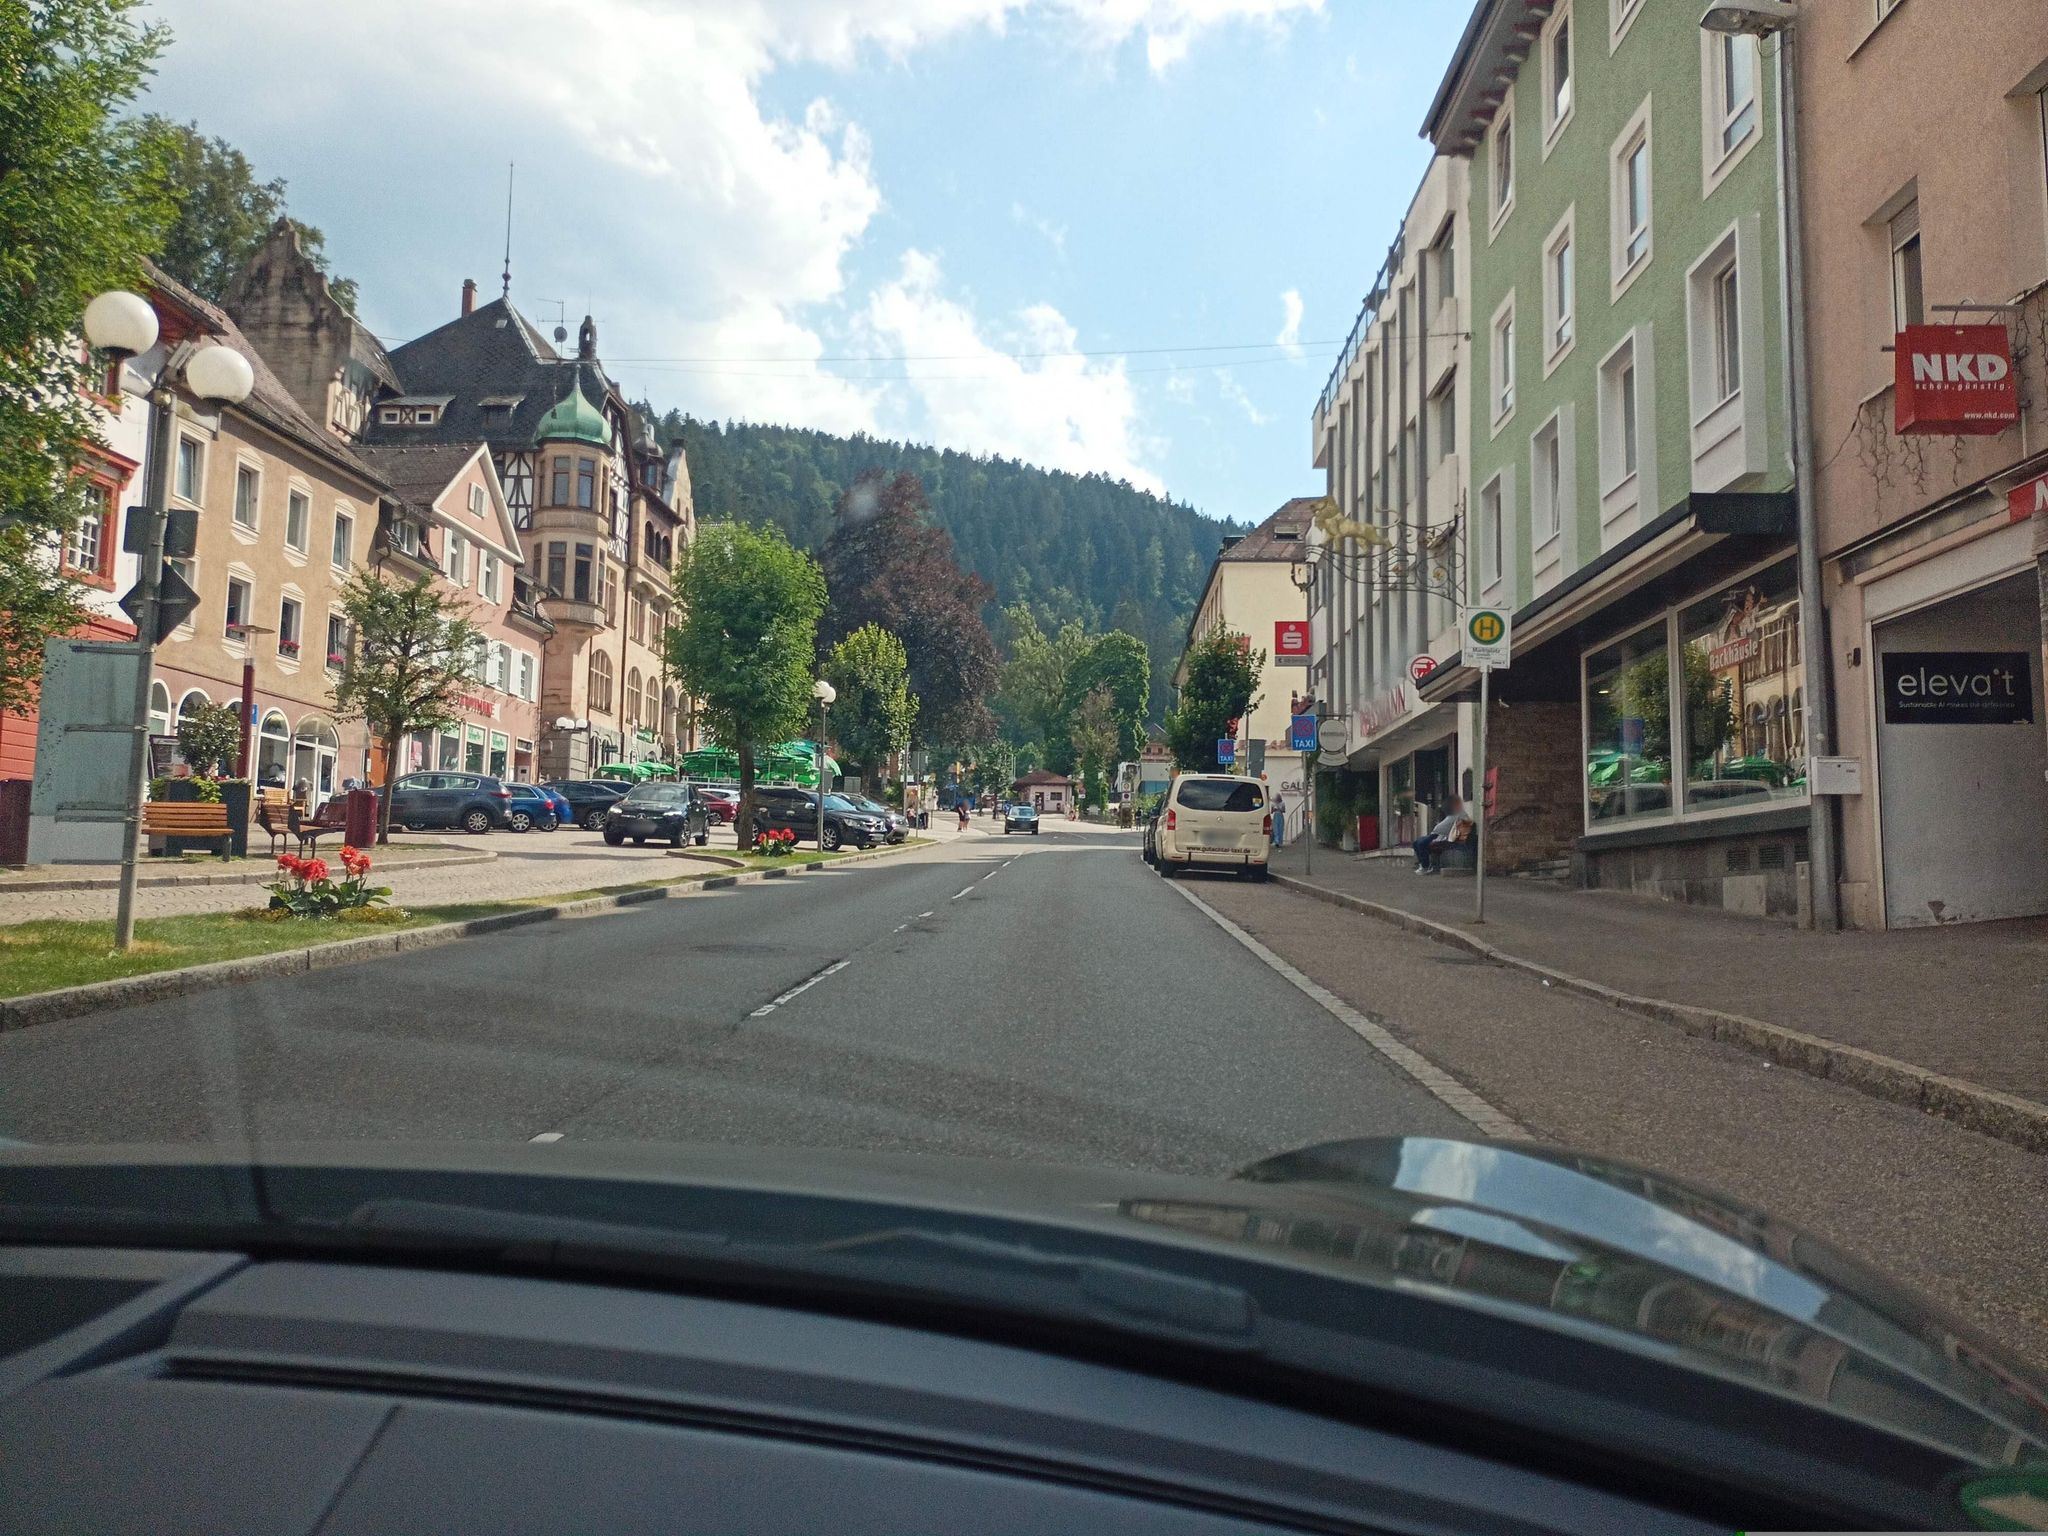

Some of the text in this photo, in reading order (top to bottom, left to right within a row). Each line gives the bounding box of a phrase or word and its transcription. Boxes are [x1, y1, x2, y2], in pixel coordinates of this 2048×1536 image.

[1912, 353, 2008, 382] NKD
[1964, 411, 2015, 420] www.nkd.com
[1479, 619, 1495, 638] H
[1295, 740, 1314, 748] TAXI
